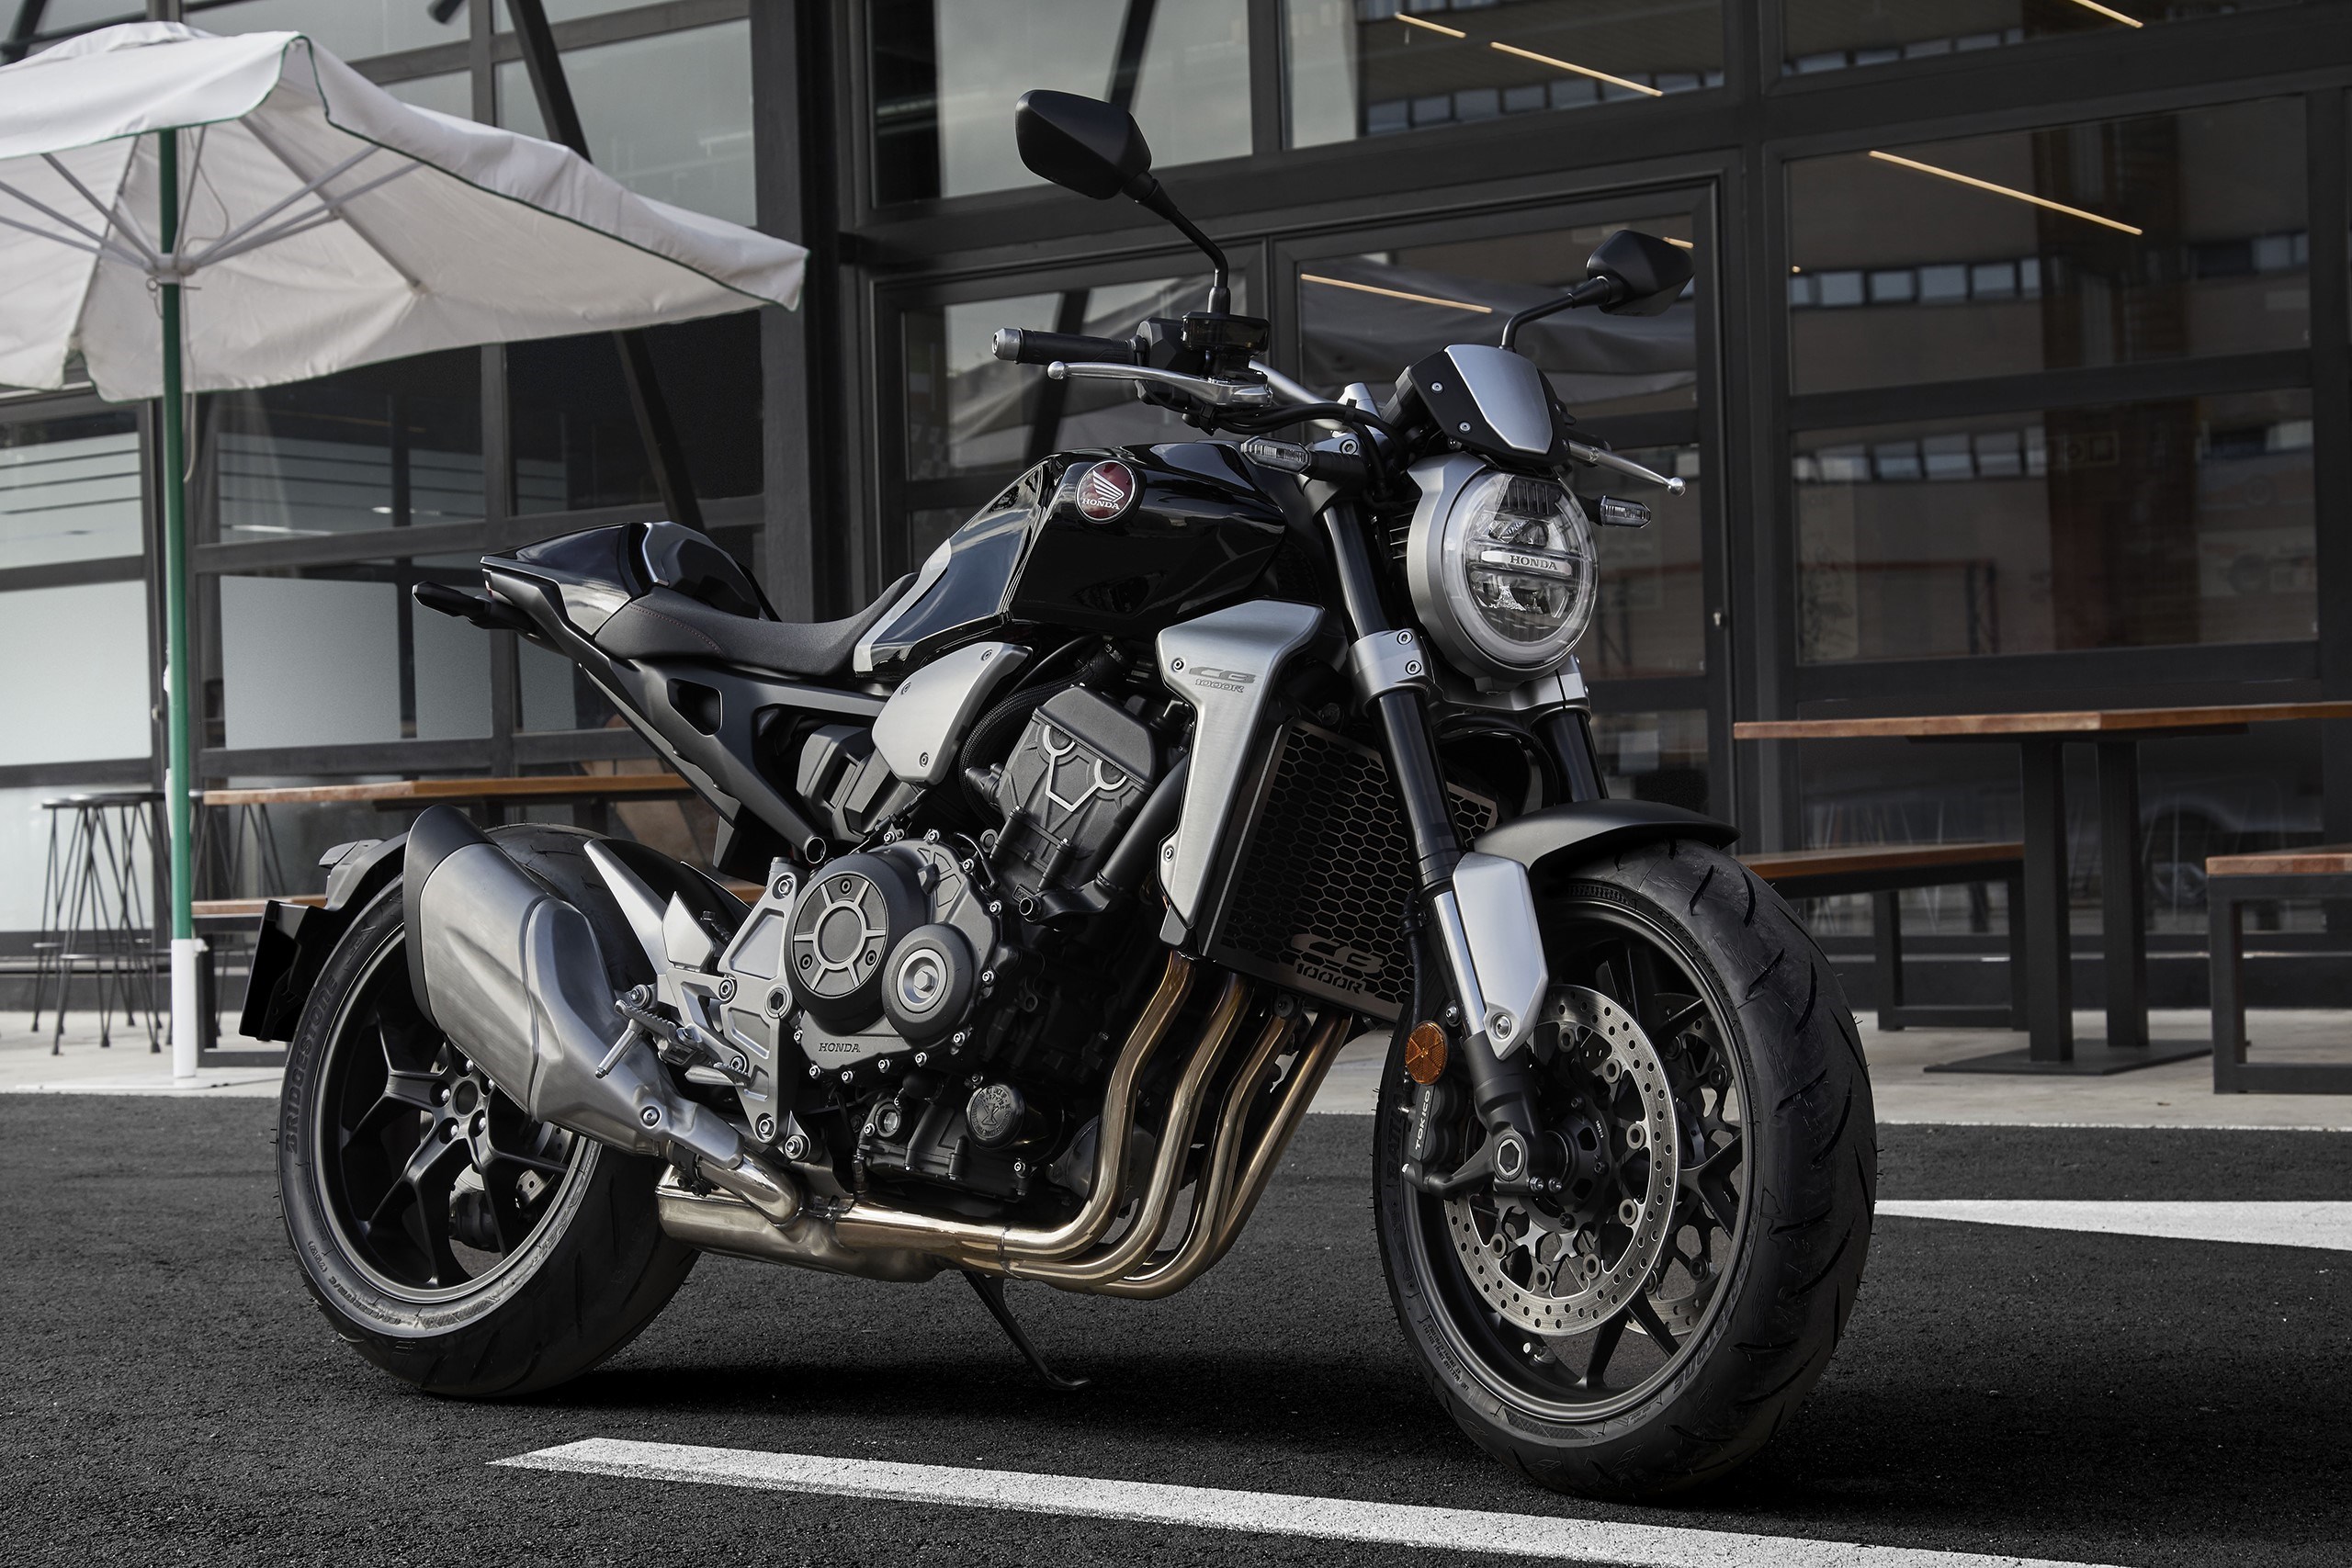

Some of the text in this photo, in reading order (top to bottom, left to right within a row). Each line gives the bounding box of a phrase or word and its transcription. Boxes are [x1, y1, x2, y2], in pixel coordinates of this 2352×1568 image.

[1082, 498, 1120, 510] HONDA
[1510, 555, 1558, 570] HONDA
[1189, 666, 1257, 683] CB
[1195, 678, 1244, 694] 1000R
[1291, 933, 1384, 974] CB
[1295, 962, 1362, 994] 1000R
[819, 1043, 861, 1053] HONDA
[285, 974, 337, 1154] BRIDGESTONE
[1415, 1090, 1430, 1150] TOKICO
